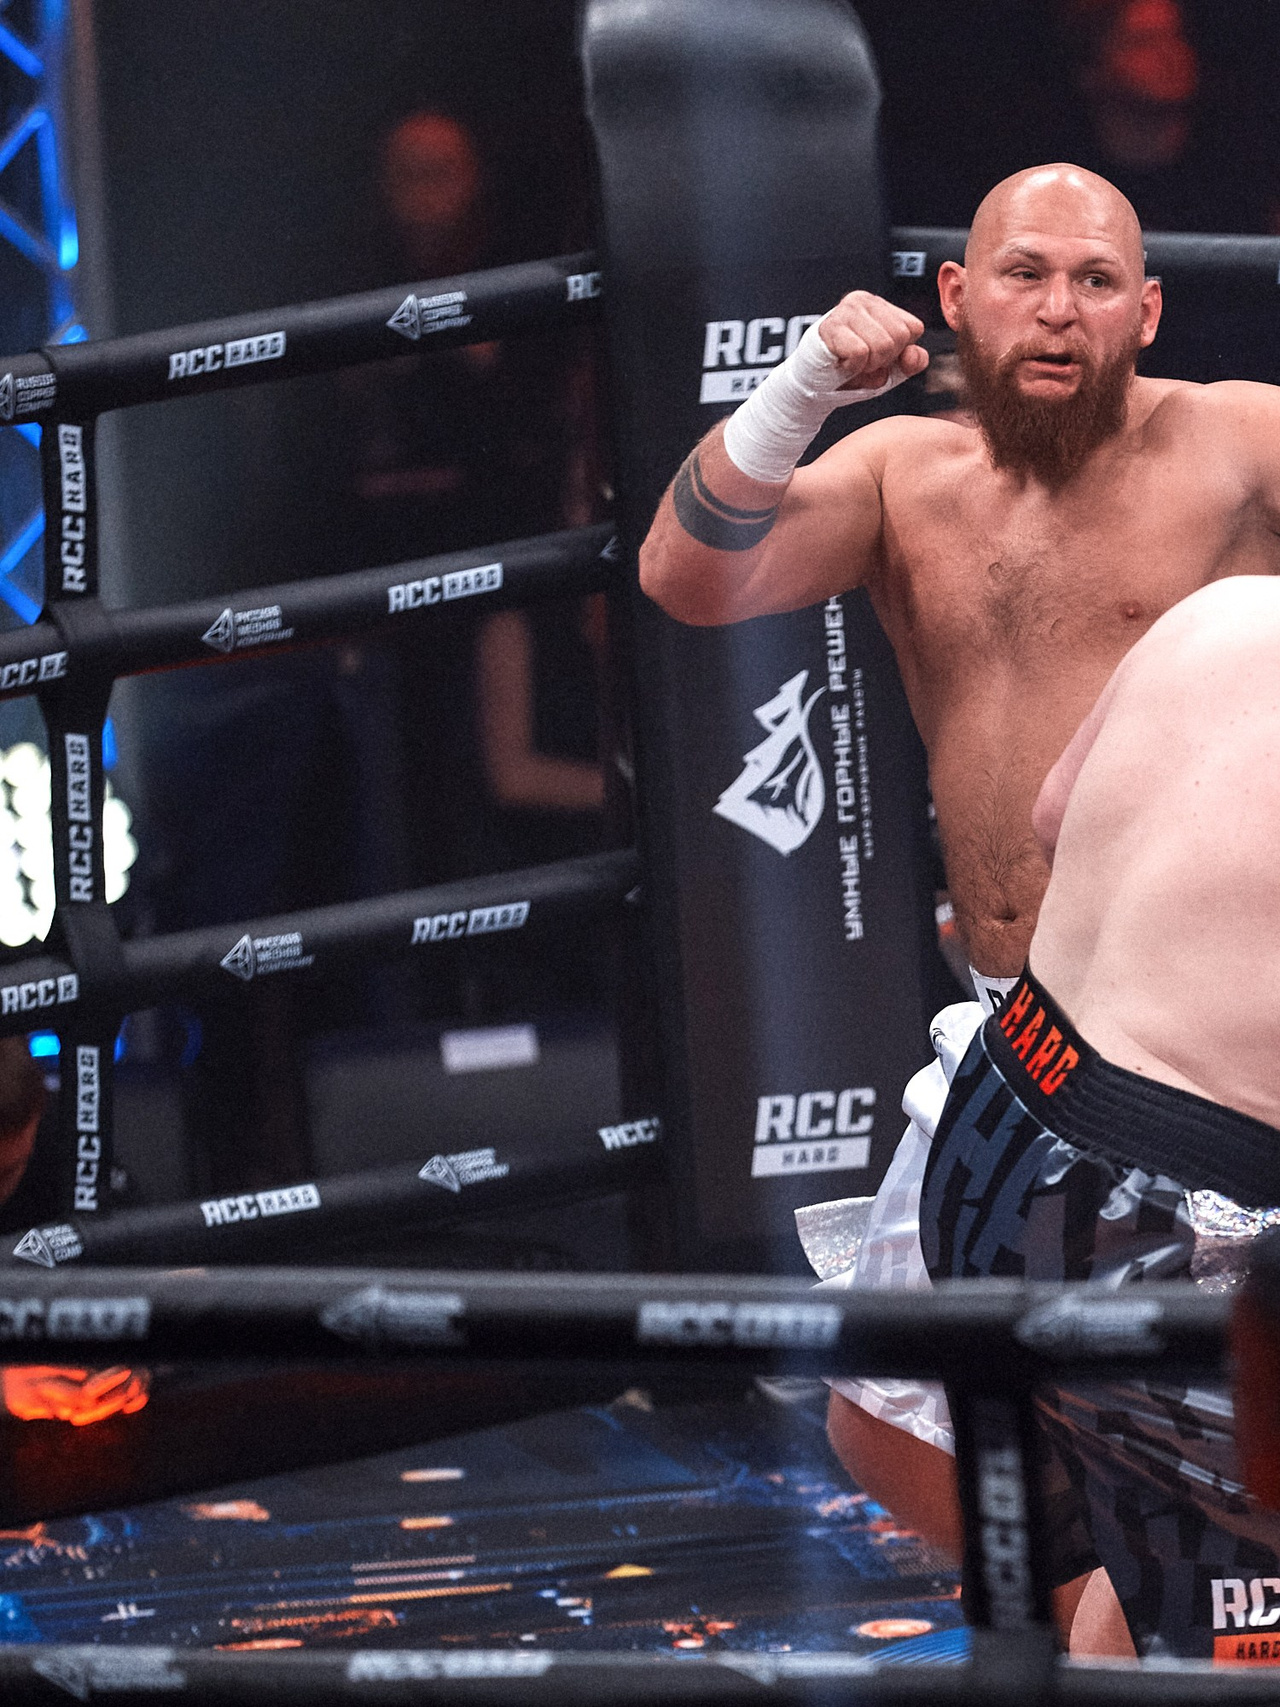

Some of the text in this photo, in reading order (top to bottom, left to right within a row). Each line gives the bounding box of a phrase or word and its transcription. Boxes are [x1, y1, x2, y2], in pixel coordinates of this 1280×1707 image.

[168, 343, 224, 380] RCC
[61, 515, 86, 591] RCC
[388, 576, 442, 614] RCC
[831, 704, 856, 824] ГОРНЫЕ
[69, 825, 94, 902] RCC
[839, 834, 864, 941] УМНЫЕ
[411, 911, 468, 944] RCC
[1, 978, 56, 1015] RCC
[598, 1118, 656, 1151] RCC
[754, 1087, 877, 1143] RCC
[74, 1135, 101, 1210] RCC
[200, 1194, 259, 1227] RCC
